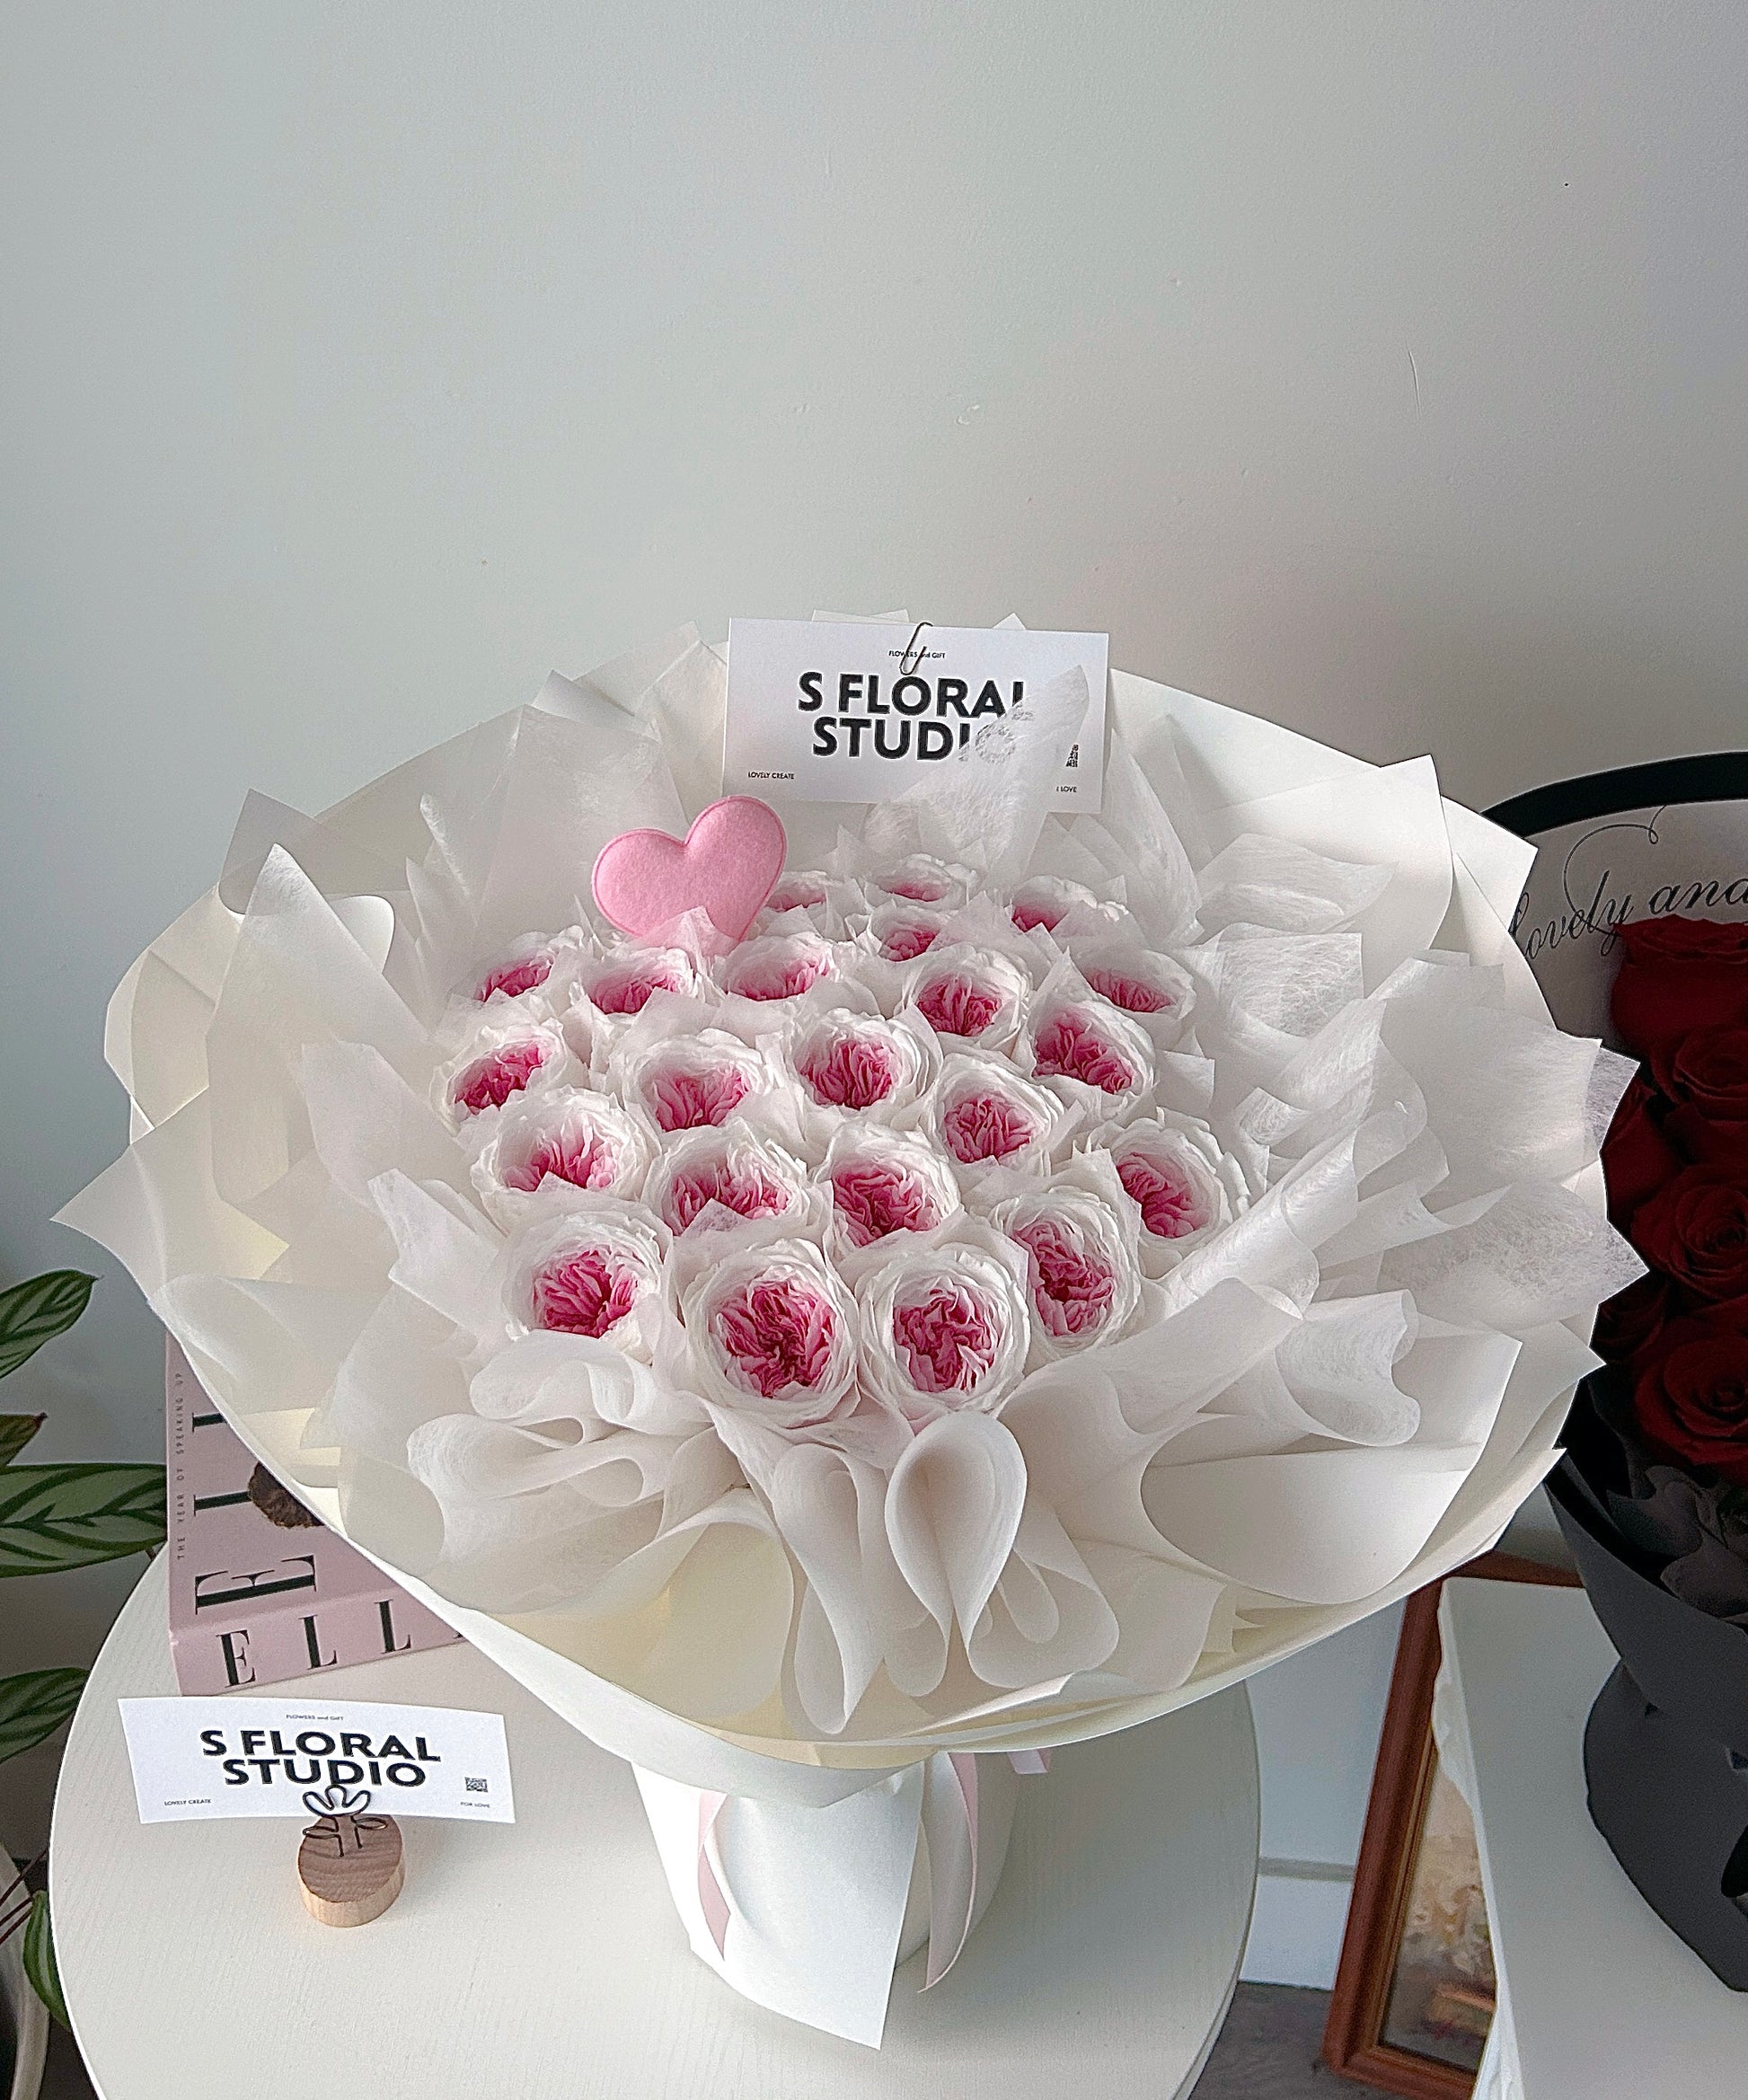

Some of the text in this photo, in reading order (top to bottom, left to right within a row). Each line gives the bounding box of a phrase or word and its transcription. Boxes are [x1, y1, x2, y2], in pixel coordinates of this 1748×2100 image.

[799, 671, 823, 711] S
[174, 1397, 185, 1455] SPEAKING
[176, 1494, 185, 1523] YEAR
[177, 1537, 185, 1559] THE
[216, 1598, 463, 1688] ELL
[200, 1730, 441, 1762] S FLORAL
[223, 1758, 427, 1787] STUDIO
